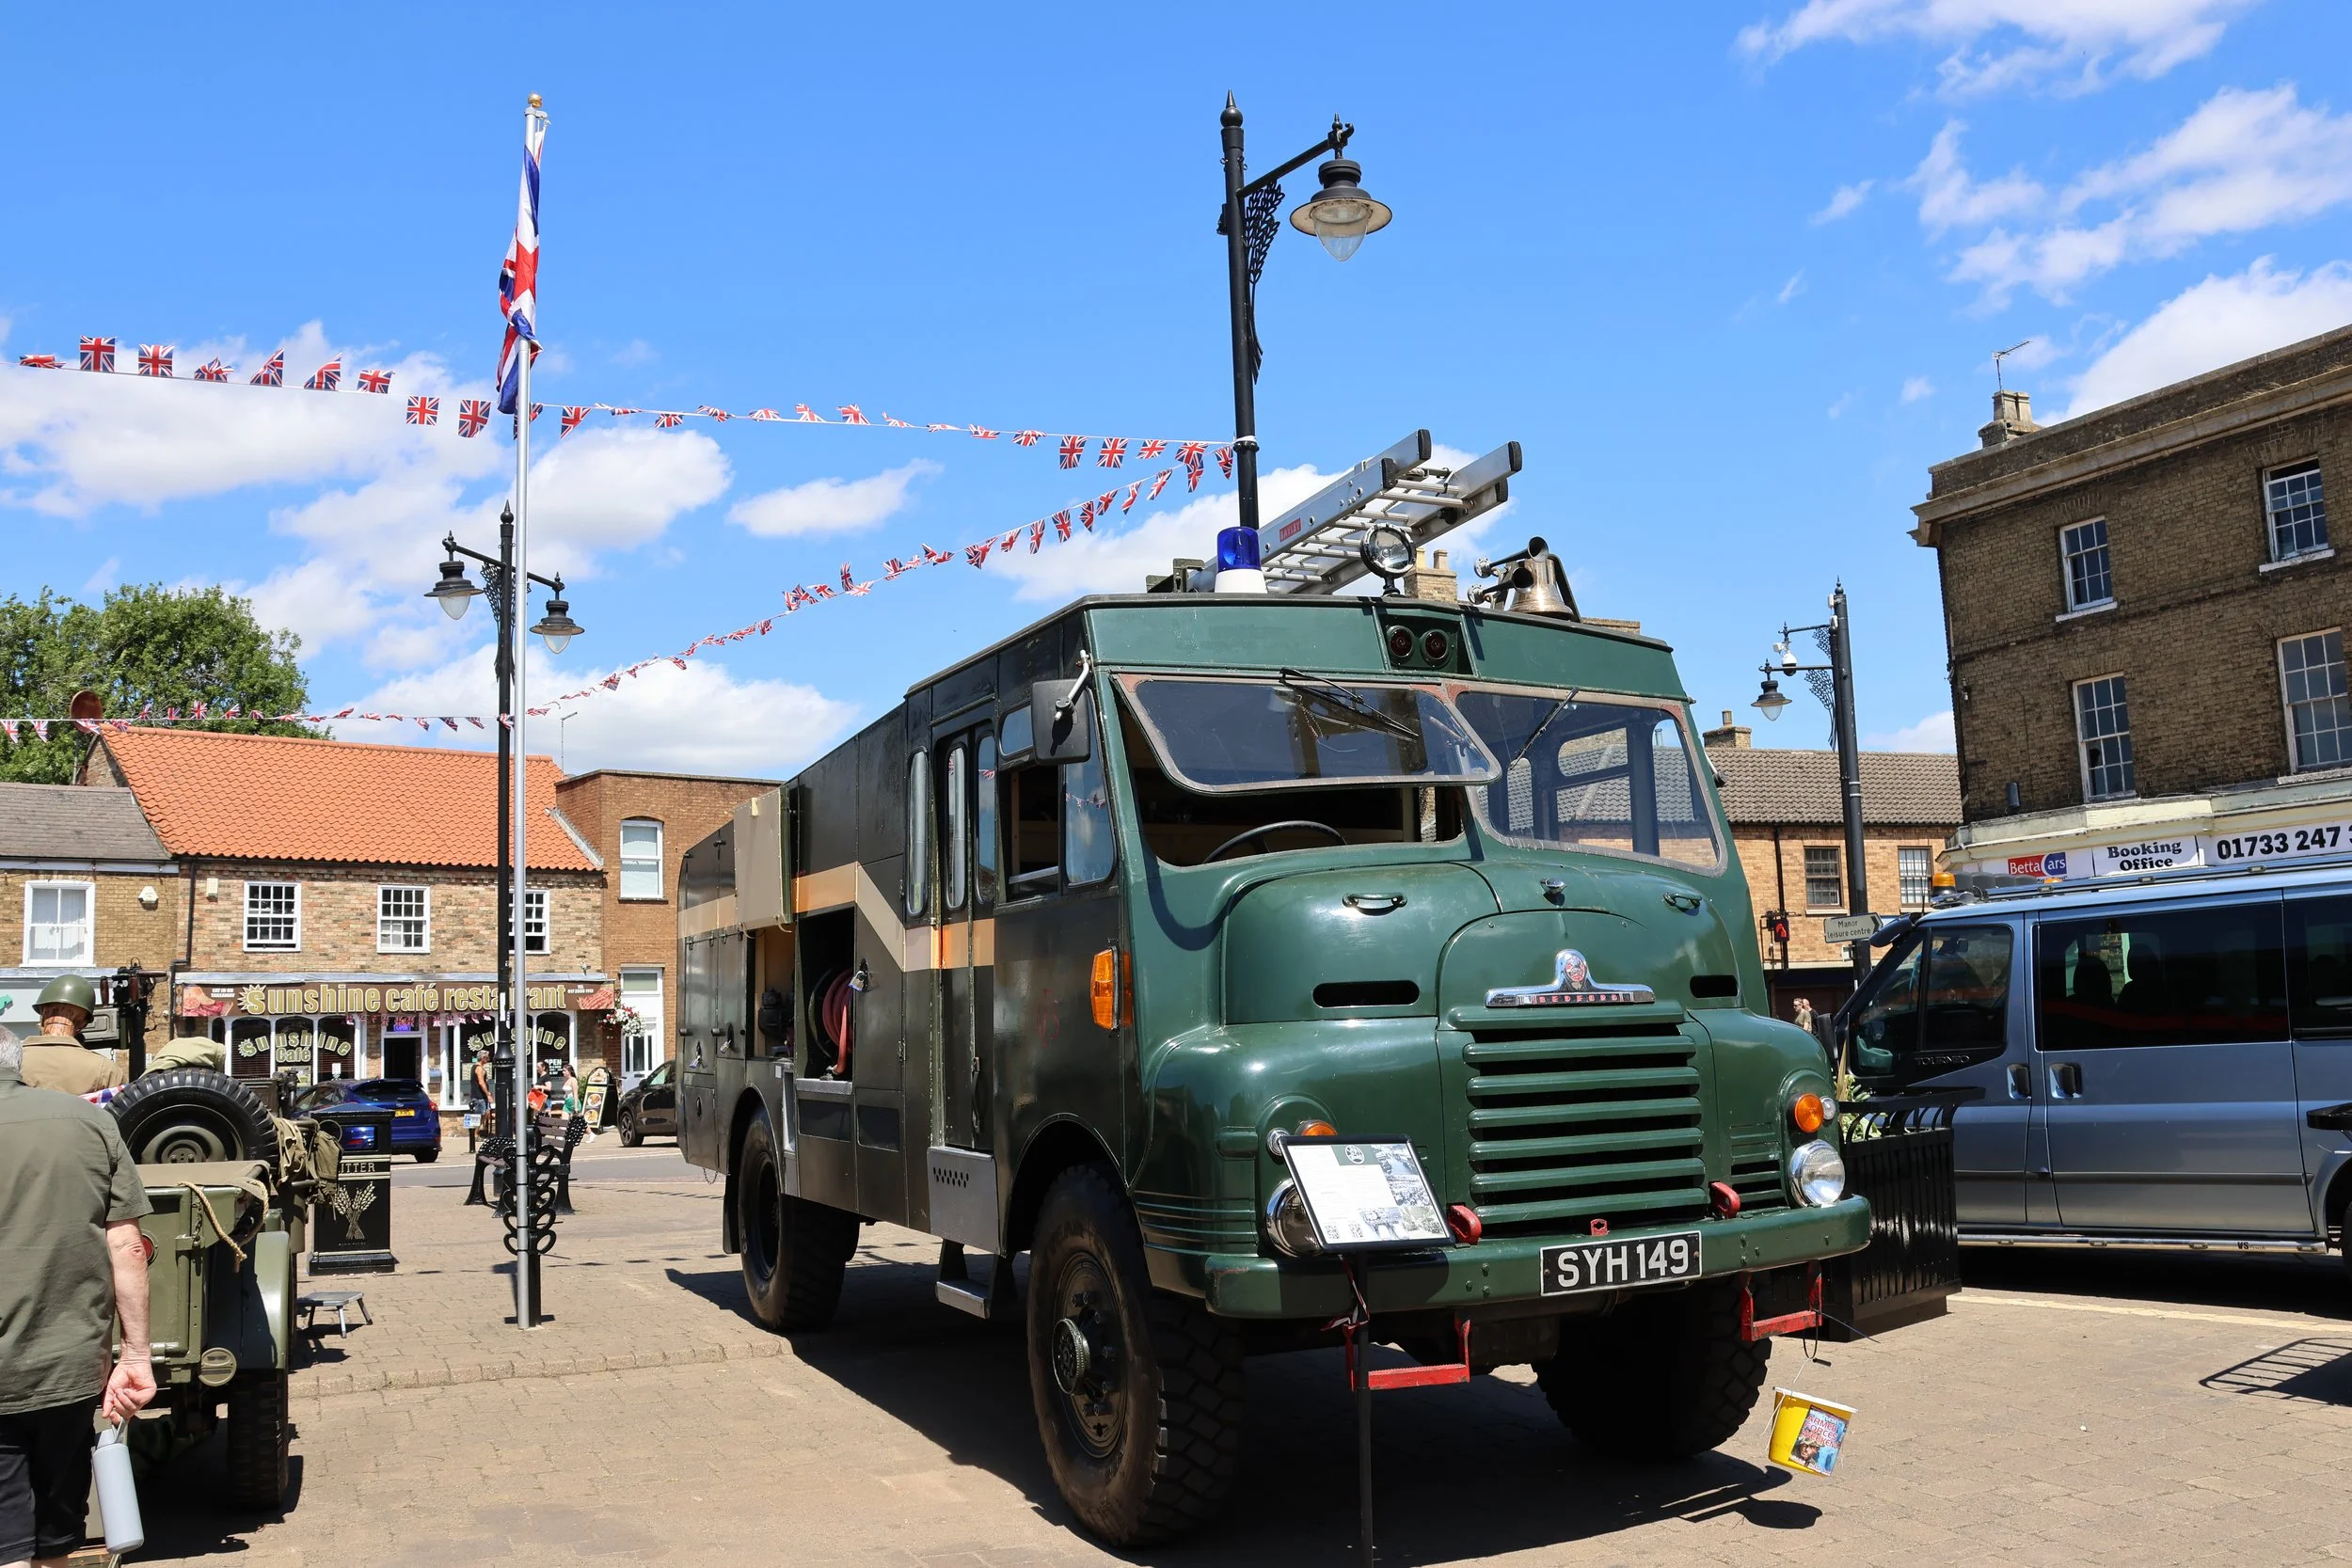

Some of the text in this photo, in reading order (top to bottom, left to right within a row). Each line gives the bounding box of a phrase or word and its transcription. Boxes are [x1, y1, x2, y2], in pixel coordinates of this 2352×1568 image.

[2106, 842, 2182, 858] Booking
[2217, 833, 2289, 860] 01733
[2295, 826, 2341, 851] 247
[2010, 862, 2041, 875] Betta
[2120, 857, 2173, 871] Office
[1851, 927, 1870, 936] centre
[386, 983, 439, 1013] café
[444, 985, 565, 1010] restaant
[1538, 993, 1618, 1004] BEDFORD
[276, 1046, 311, 1063] Café
[1914, 1054, 1970, 1065] TOURNEO
[338, 1163, 375, 1173] ITTER
[1557, 1239, 1689, 1288] SYH 149
[1804, 1421, 1837, 1440] FORCES
